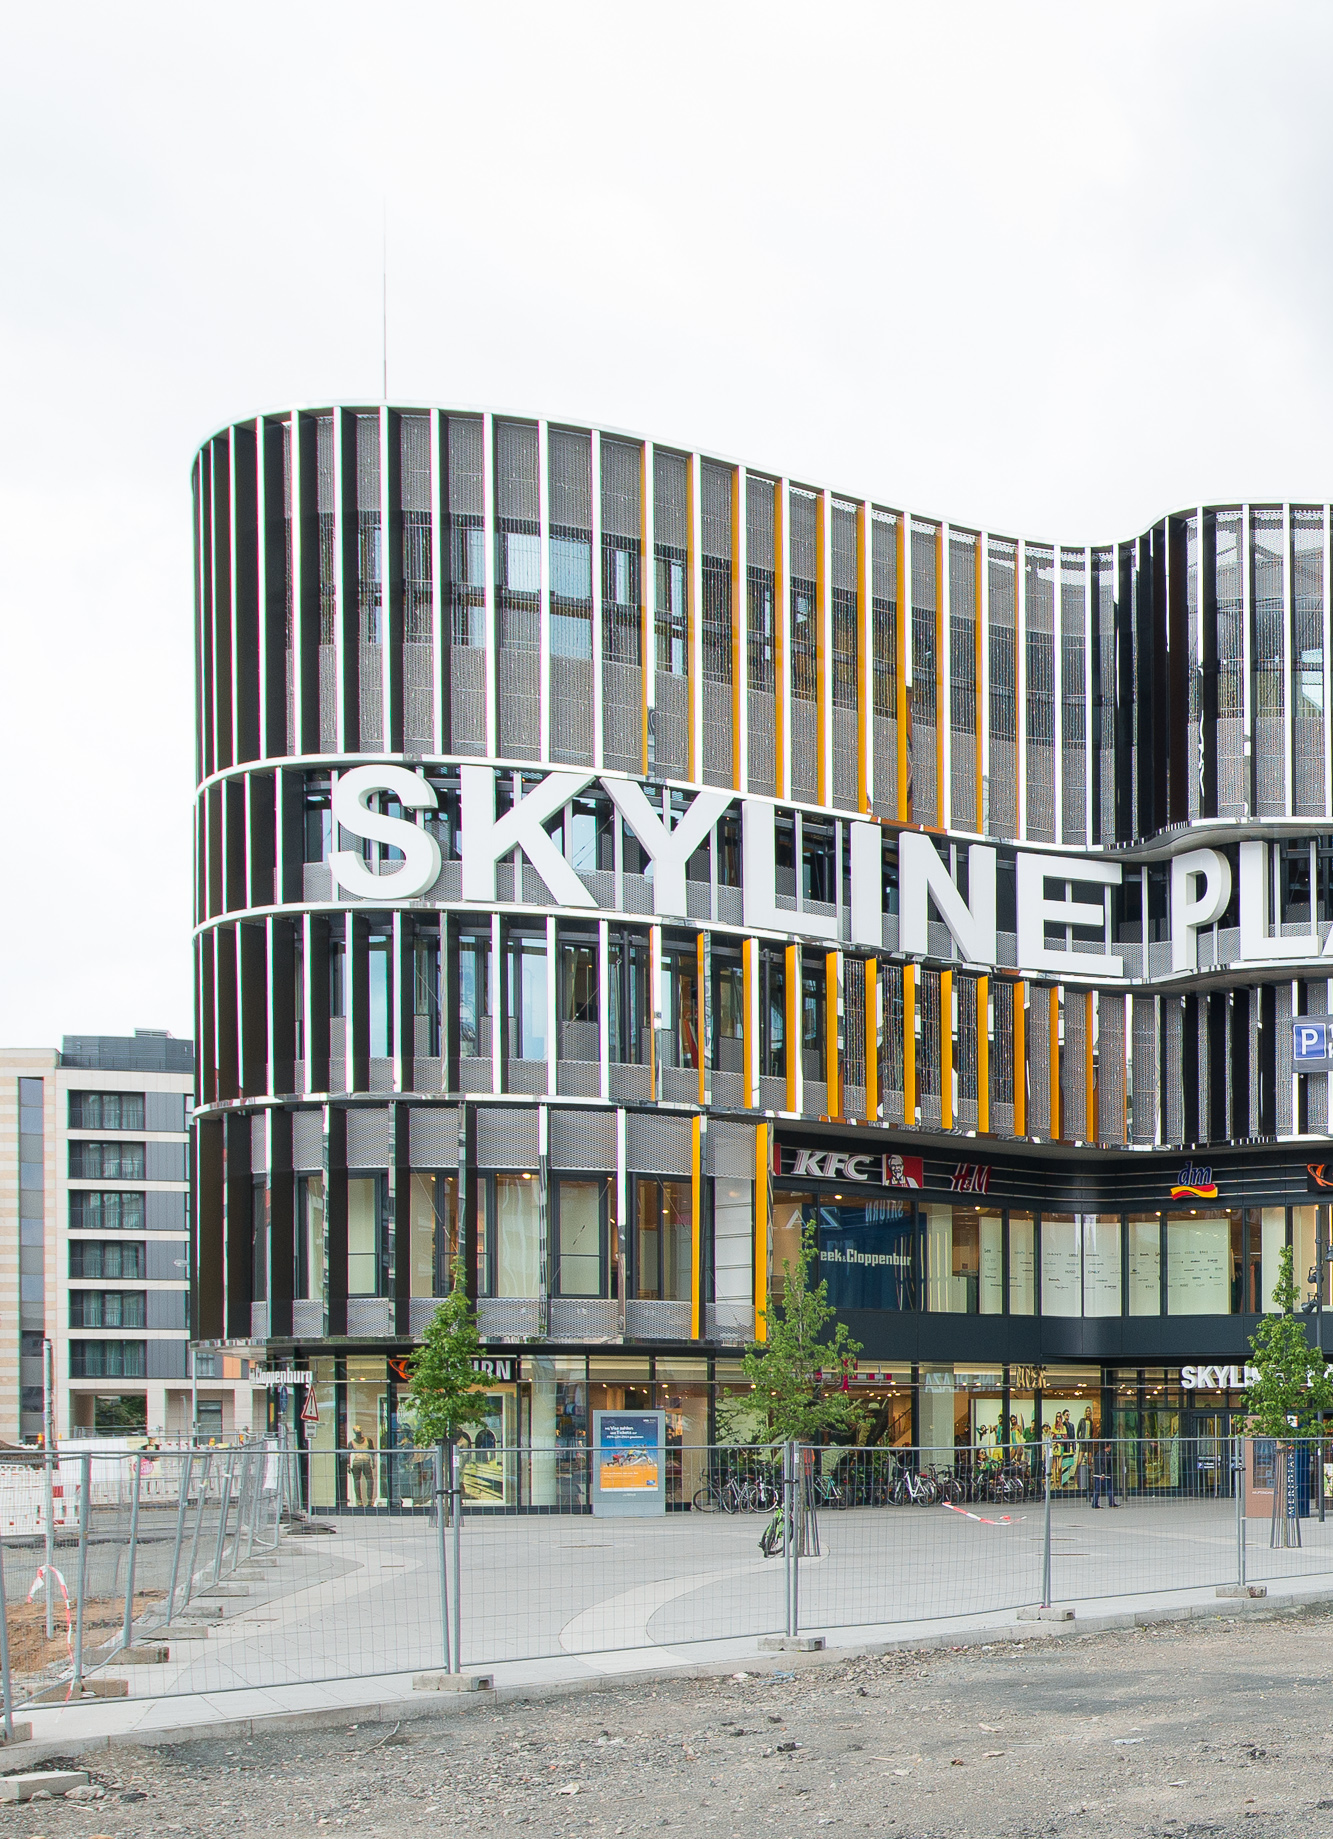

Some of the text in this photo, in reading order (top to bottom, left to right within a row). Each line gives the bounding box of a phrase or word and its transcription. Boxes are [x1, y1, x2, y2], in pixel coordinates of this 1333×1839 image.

[328, 764, 1123, 977] SKYLINE
[790, 1150, 873, 1181] KFC
[951, 1163, 992, 1195] H&M
[1177, 1160, 1213, 1187] dm
